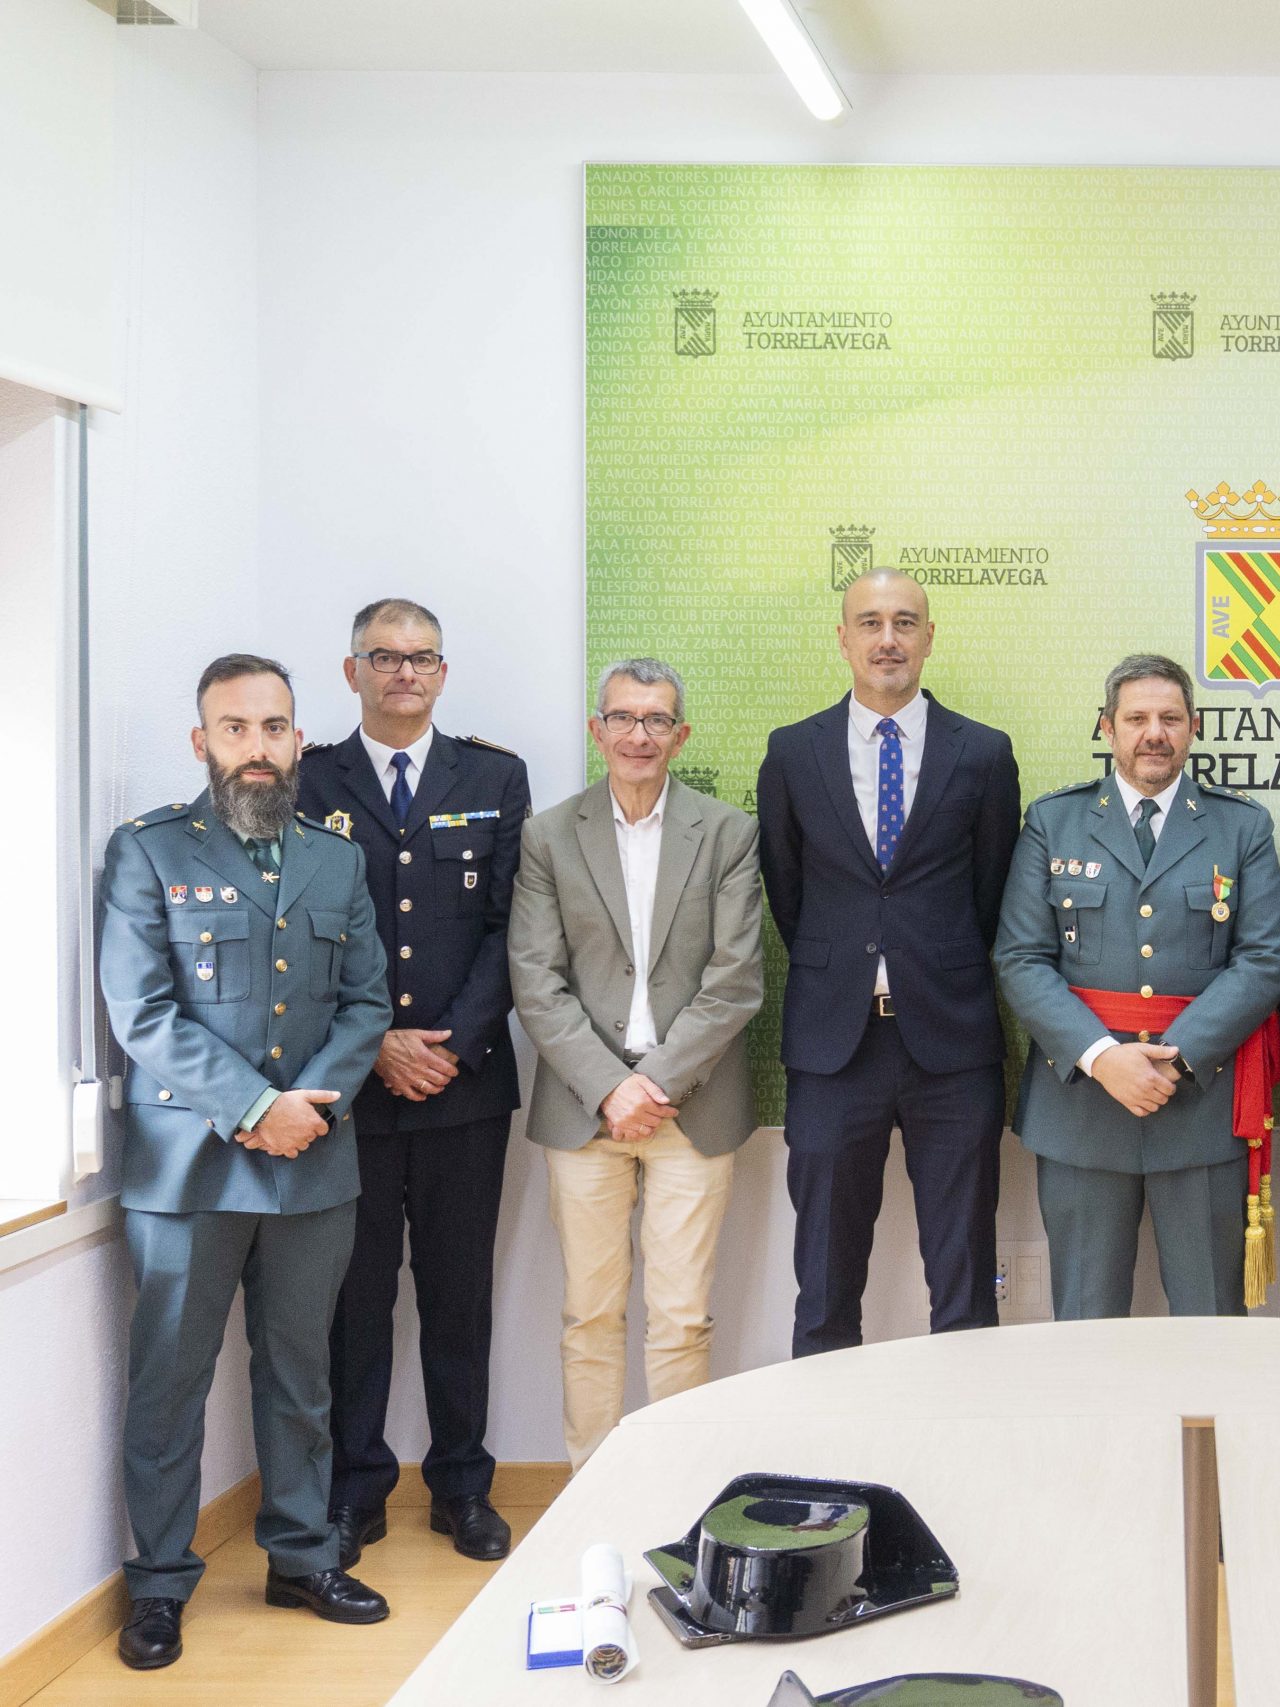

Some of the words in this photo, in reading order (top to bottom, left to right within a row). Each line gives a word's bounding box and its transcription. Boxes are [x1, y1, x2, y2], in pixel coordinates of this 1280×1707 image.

[657, 171, 708, 184] TORRES
[714, 169, 767, 184] DUÁLEZ
[772, 171, 821, 184] GANZO
[637, 185, 715, 198] GARCILASO
[721, 183, 755, 198] PEÑA
[641, 199, 674, 212] REAL
[679, 199, 749, 212] SOCIEDAD
[593, 214, 654, 227] NUREYEV
[661, 213, 677, 226] DE
[683, 213, 740, 226] CUATRO
[745, 214, 809, 227] CAMINOS
[643, 227, 661, 240] DE
[667, 227, 682, 240] LA
[688, 227, 723, 240] VEGA
[782, 228, 825, 241] FREIRE
[687, 241, 701, 254] EL
[761, 241, 778, 254] DE
[784, 242, 830, 255] TANOS
[684, 255, 760, 268] TELESFORO
[766, 256, 834, 269] MALLAVIA
[651, 269, 720, 282] DEMETRIO
[726, 270, 796, 283] HERREROS
[622, 283, 657, 296] CASA
[744, 284, 778, 297] CLUB
[784, 284, 862, 297] DEPORTIVO
[868, 282, 939, 297] TROPEZÓN
[743, 311, 892, 328] AYUNTAMIENTO
[744, 332, 891, 350] TORRELAVEGA
[656, 381, 686, 396] JOSÉ
[691, 383, 732, 396] LUCIO
[739, 383, 818, 396] MEDIAVILLA
[825, 383, 859, 396] CLUB
[865, 384, 928, 397] VOLEIBOL
[687, 397, 726, 410] CORO
[732, 397, 776, 410] SANTA
[832, 397, 848, 410] DE
[854, 398, 907, 411] SOLVAY
[612, 410, 657, 423] NIEVES
[663, 411, 720, 424] ENRIQUE
[727, 411, 815, 424] CAMPUZANO
[635, 425, 652, 438] DE
[657, 425, 713, 438] DANZAS
[718, 425, 744, 438] SAN
[751, 425, 793, 438] PABLO
[676, 439, 771, 452] SIERRAPANDO
[639, 453, 708, 466] MURIEDAS
[714, 453, 780, 466] FEDERICO
[785, 454, 853, 467] MALLAVIA
[605, 467, 659, 480] AMIGOS
[665, 467, 689, 480] DEL
[695, 468, 785, 481] BALONCESTO
[624, 481, 689, 494] COLLADO
[696, 482, 732, 495] SOTO
[739, 482, 782, 495] NOBEL
[673, 510, 740, 523] EDUARDO
[746, 510, 795, 523] PISANO
[900, 547, 1049, 564] AYUNTAMIENTO
[658, 594, 728, 607] HERREROS
[940, 610, 1015, 623] DEPORTIVA
[1211, 595, 1230, 639] AVE
[643, 623, 721, 636] ESCALANTE
[726, 623, 803, 636] VICTORINO
